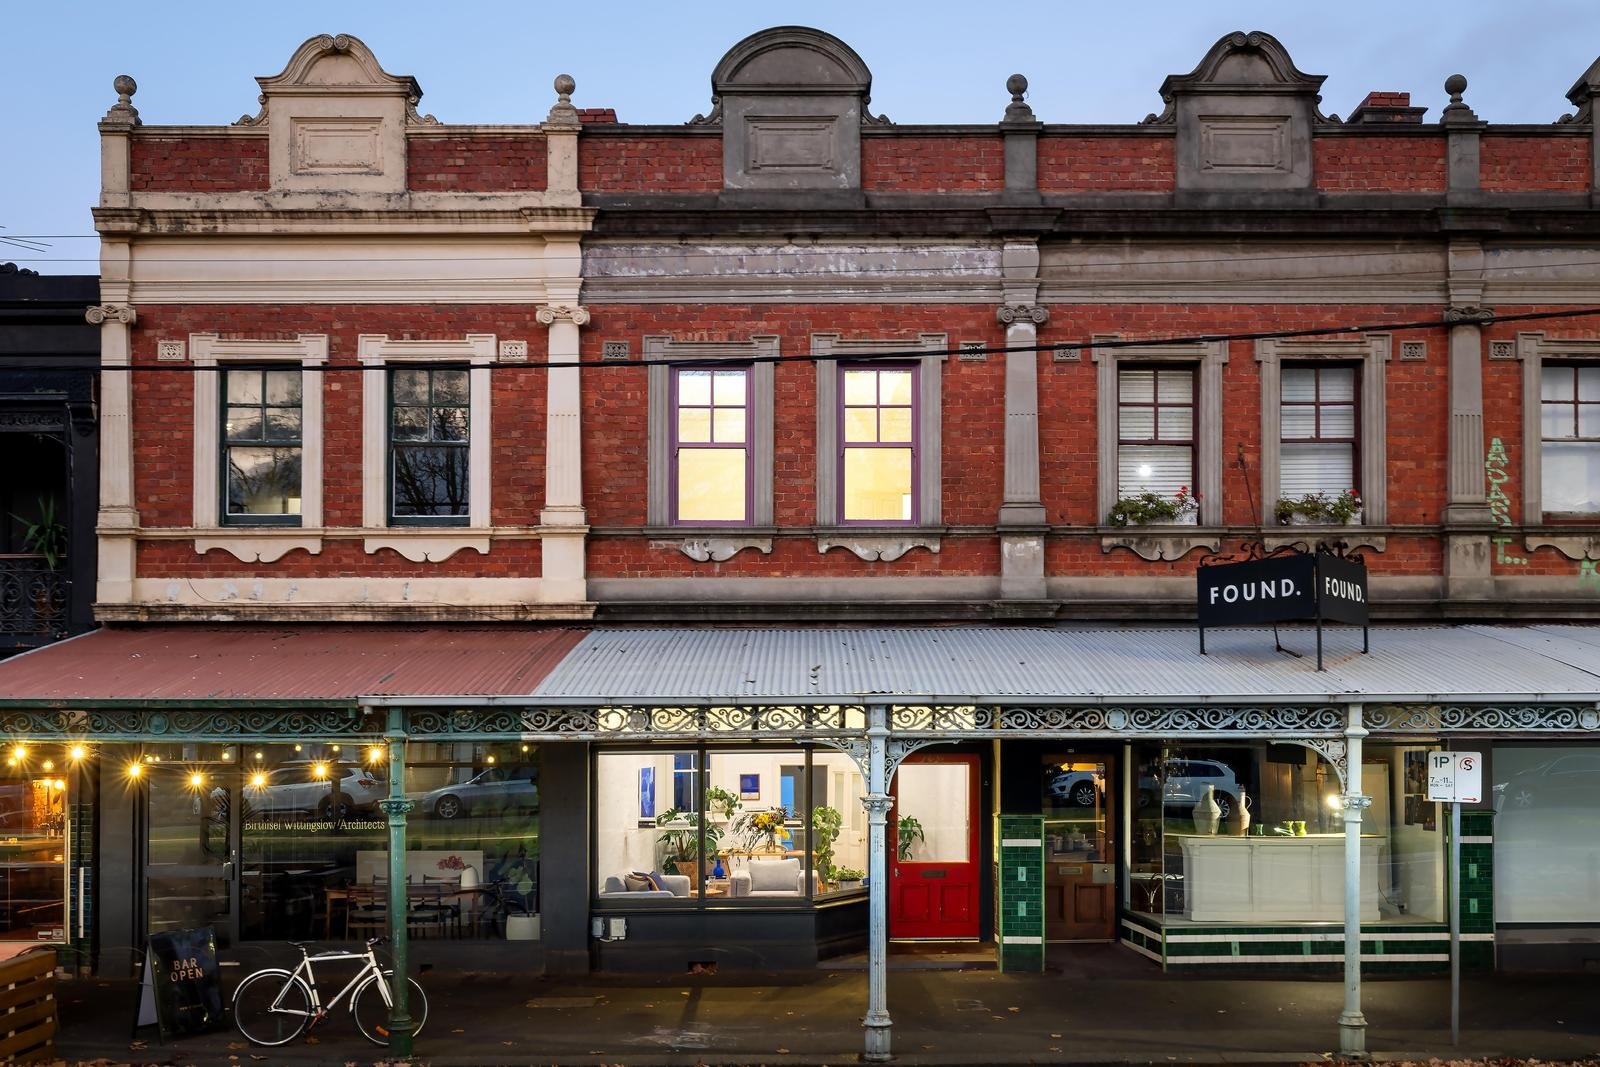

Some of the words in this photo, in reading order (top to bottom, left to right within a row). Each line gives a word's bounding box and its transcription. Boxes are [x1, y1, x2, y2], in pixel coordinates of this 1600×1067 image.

[1210, 578, 1302, 605] FOUND.
[1325, 577, 1365, 604] FOUND.
[1433, 756, 1450, 768] 1P
[173, 957, 198, 971] BAR
[170, 967, 204, 982] OPEN
